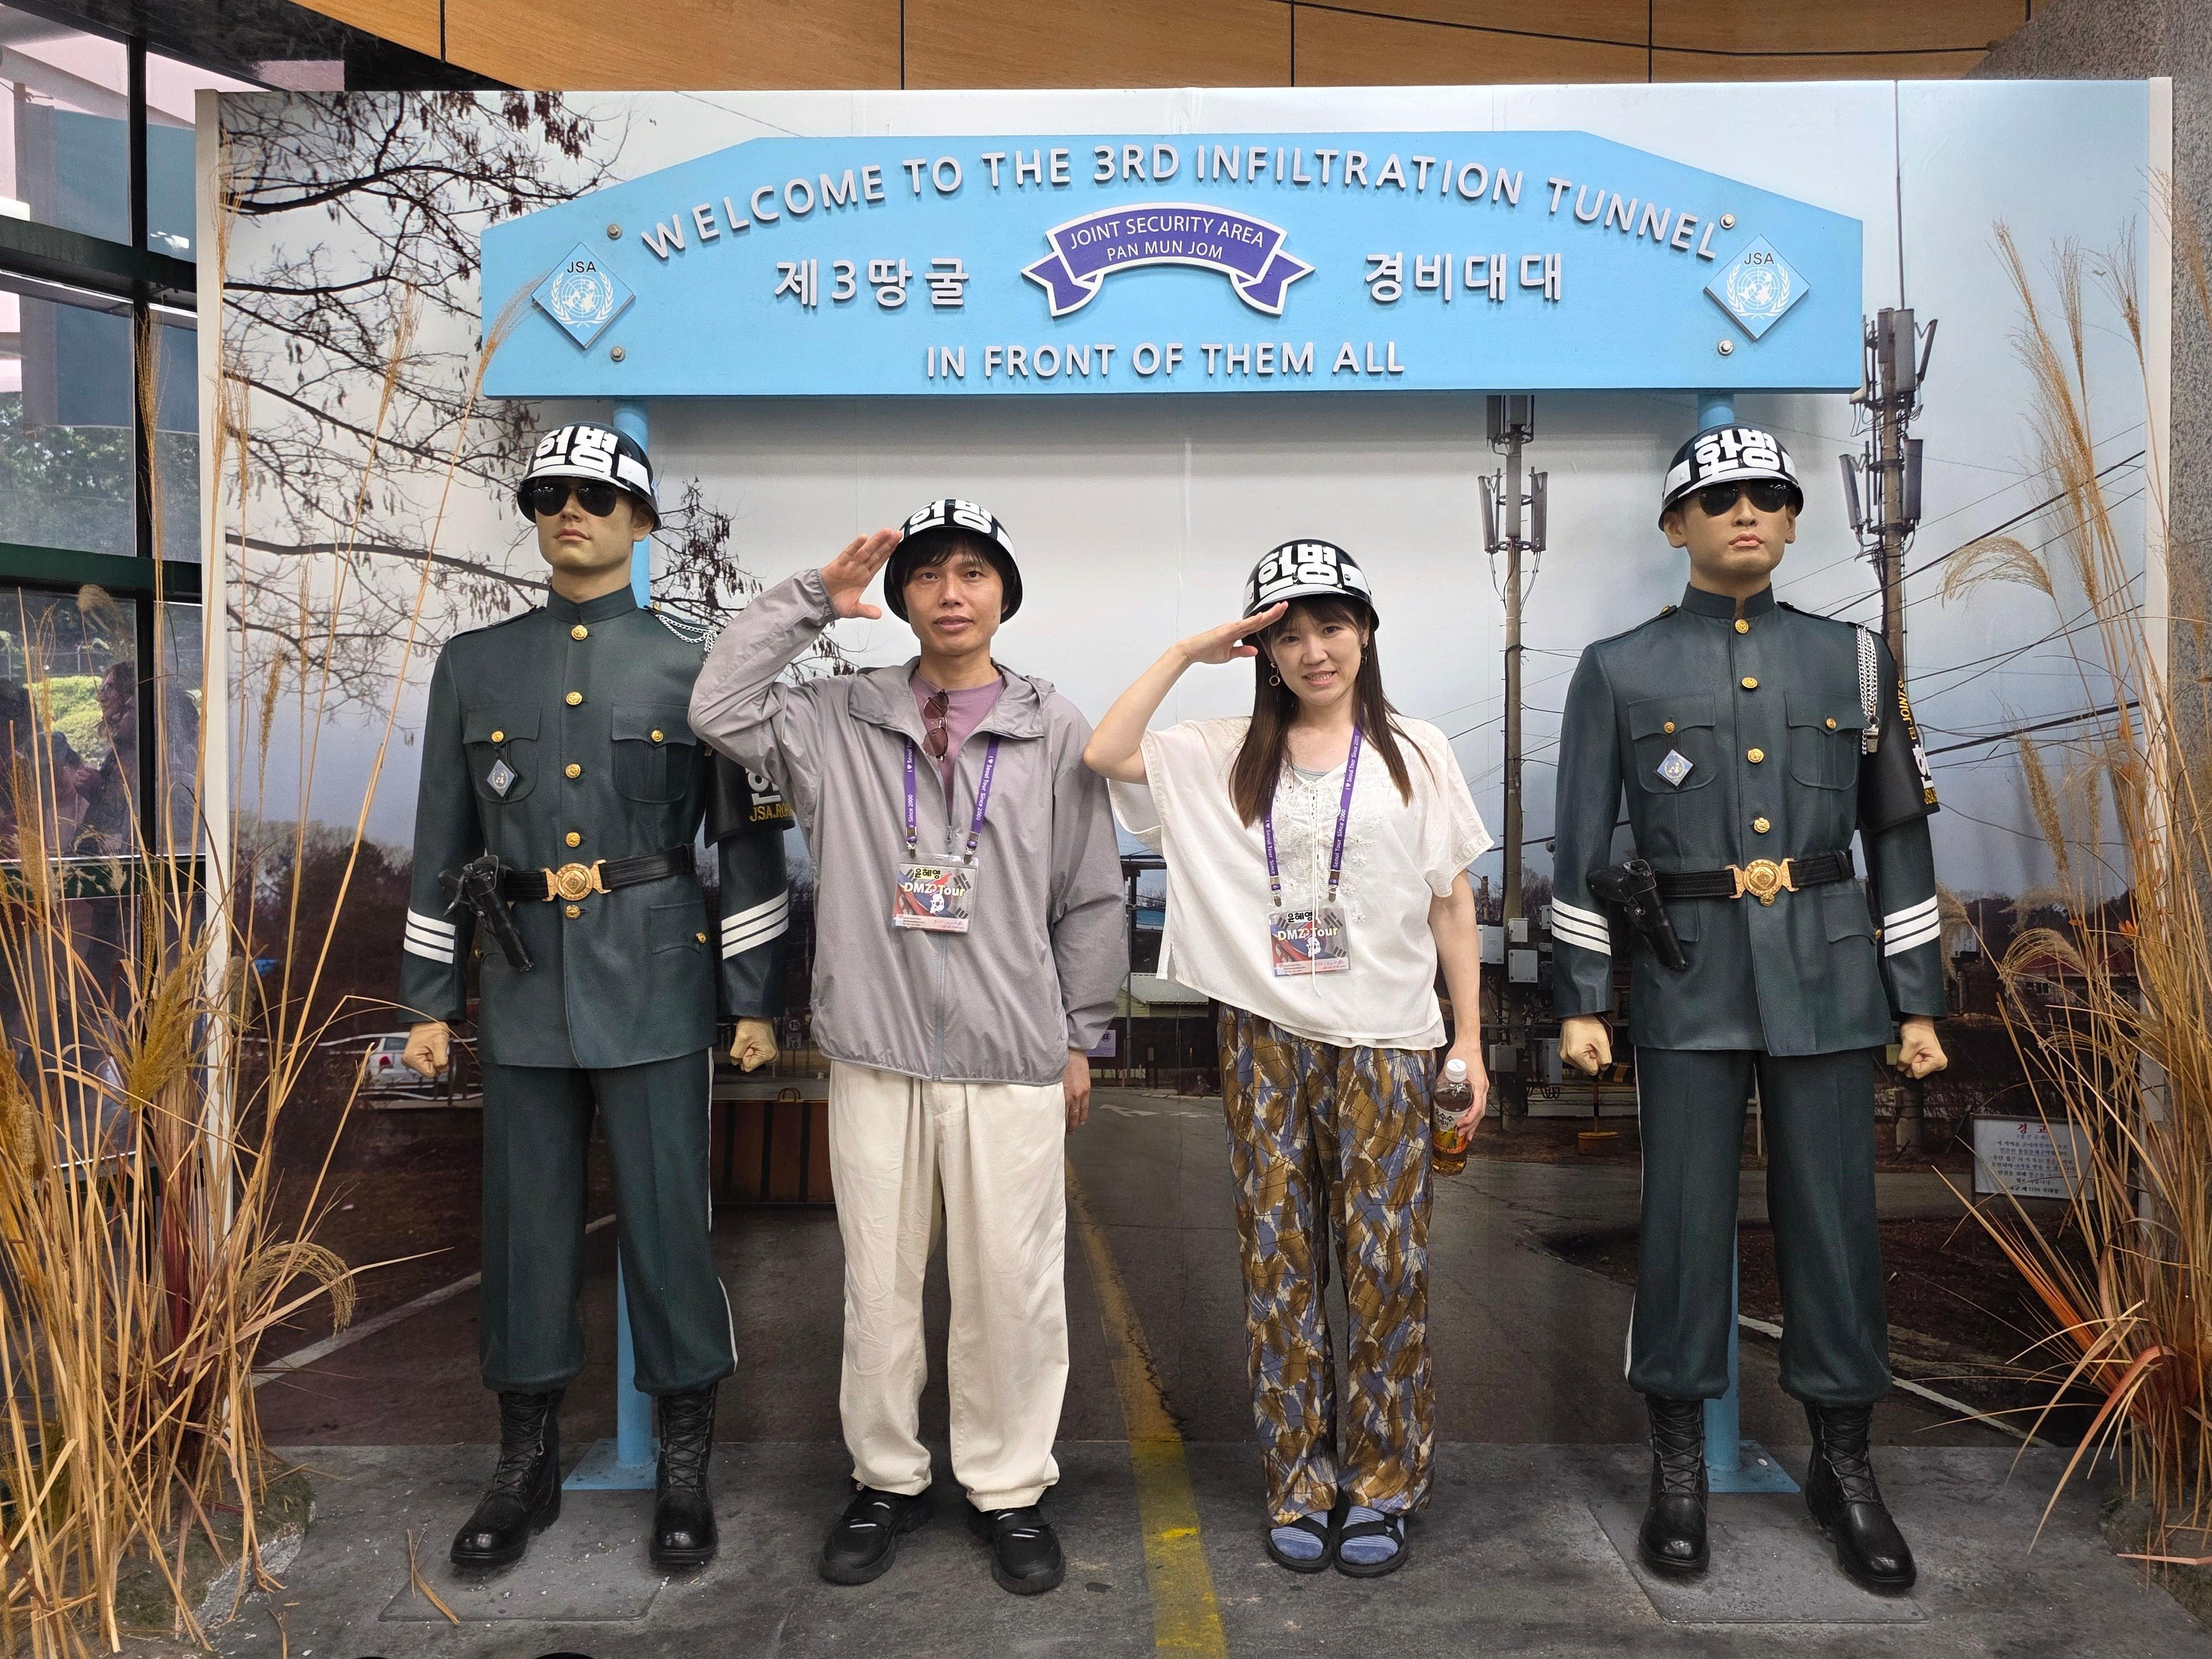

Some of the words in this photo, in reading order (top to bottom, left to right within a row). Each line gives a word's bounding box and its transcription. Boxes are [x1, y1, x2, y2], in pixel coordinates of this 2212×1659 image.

[641, 164, 885, 259] WELCOME
[902, 156, 962, 193] TO
[982, 147, 1071, 186] THE
[1094, 144, 1179, 180] 3RD
[1197, 144, 1524, 205] INFILTRATION
[1548, 177, 1717, 259] TUNNEL
[1071, 221, 1120, 249] JOINT
[1127, 216, 1214, 235] SECURITY
[1217, 221, 1263, 248] AREA
[1107, 243, 1139, 261] PAN
[1145, 240, 1182, 254] MUN
[1188, 242, 1223, 259] JOM
[1744, 252, 1775, 265] JSA
[567, 261, 597, 273] JSA
[1365, 252, 1562, 302] 경비대대
[927, 346, 965, 377] IN
[985, 343, 1116, 377] FRONT
[1133, 342, 1183, 375] OF
[1201, 341, 1314, 374] THEM
[1332, 341, 1405, 373] ALL
[904, 882, 932, 894] DMZ
[938, 885, 965, 896] Tour
[1278, 928, 1306, 941] DMZ
[1311, 927, 1338, 937] Tour
